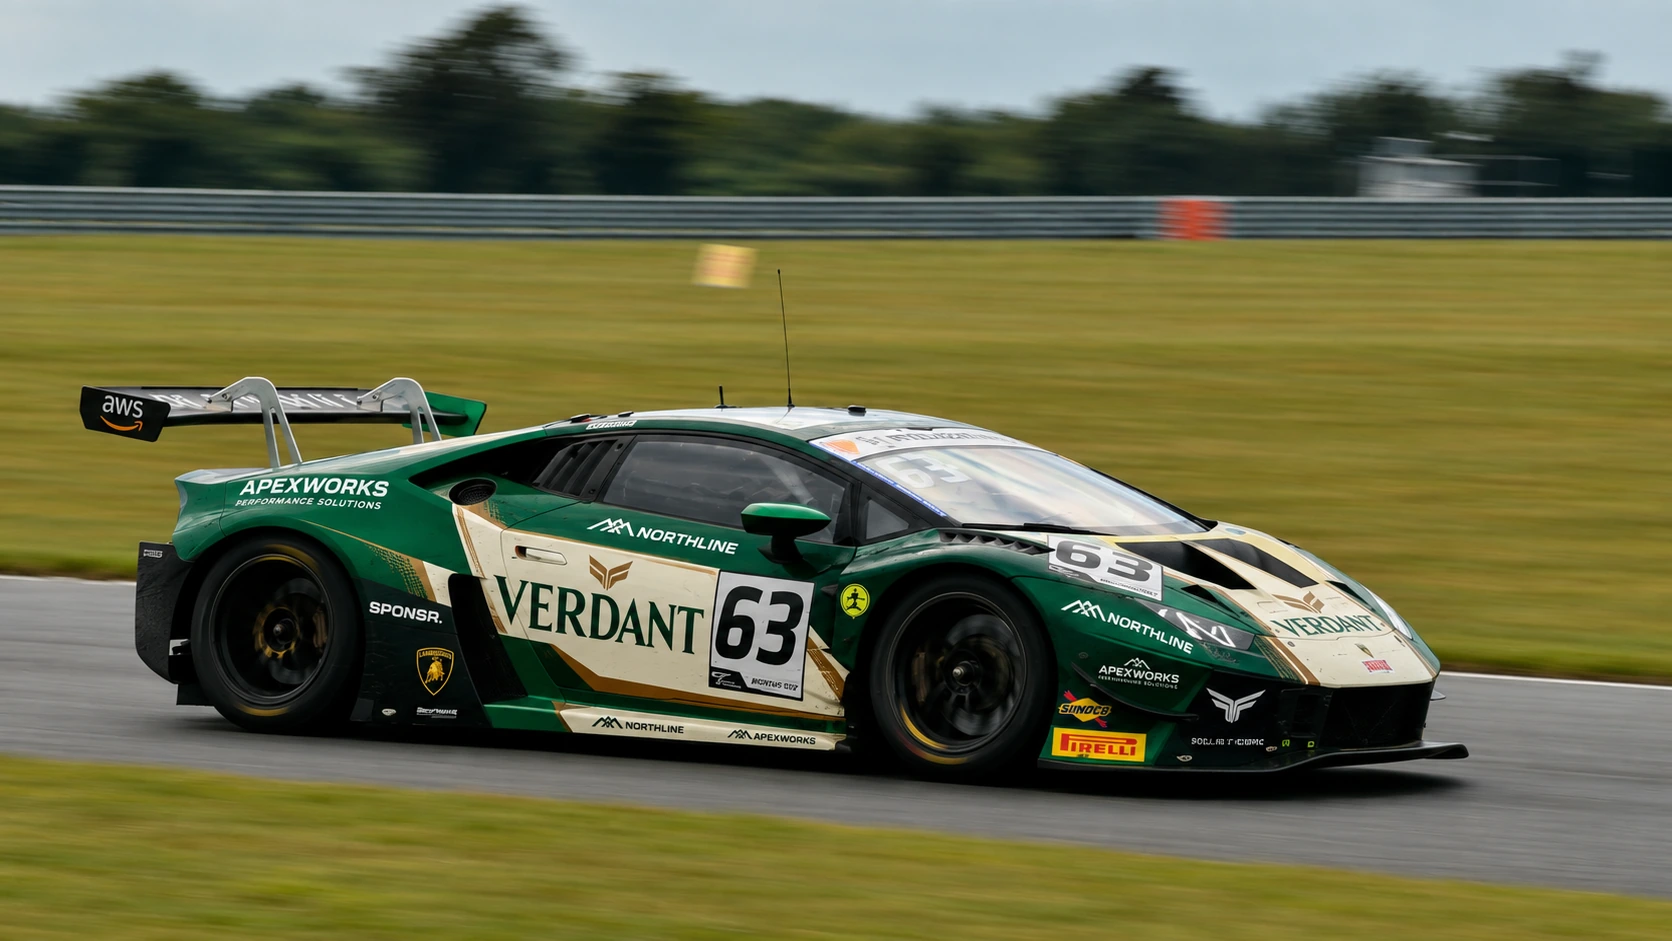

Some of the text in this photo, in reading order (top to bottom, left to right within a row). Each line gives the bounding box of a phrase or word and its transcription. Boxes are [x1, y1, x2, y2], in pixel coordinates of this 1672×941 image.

[102, 394, 144, 419] aws
[239, 477, 390, 497] APEXWORKS
[235, 497, 382, 510] PERFORMANCE SOLUTIONS
[636, 526, 739, 555] NORTHLINE
[1055, 540, 1154, 582] 63
[368, 601, 443, 624] SPONSR.
[493, 574, 705, 655] VERDANT
[715, 585, 804, 666] 63
[1106, 612, 1195, 654] NORTHLINE
[1270, 614, 1383, 637] VERDANT
[1098, 664, 1180, 684] APEXWORKS
[625, 721, 684, 734] NORTHLINE
[753, 733, 816, 745] APEXWORKS
[1060, 733, 1137, 756] PIRELLI
